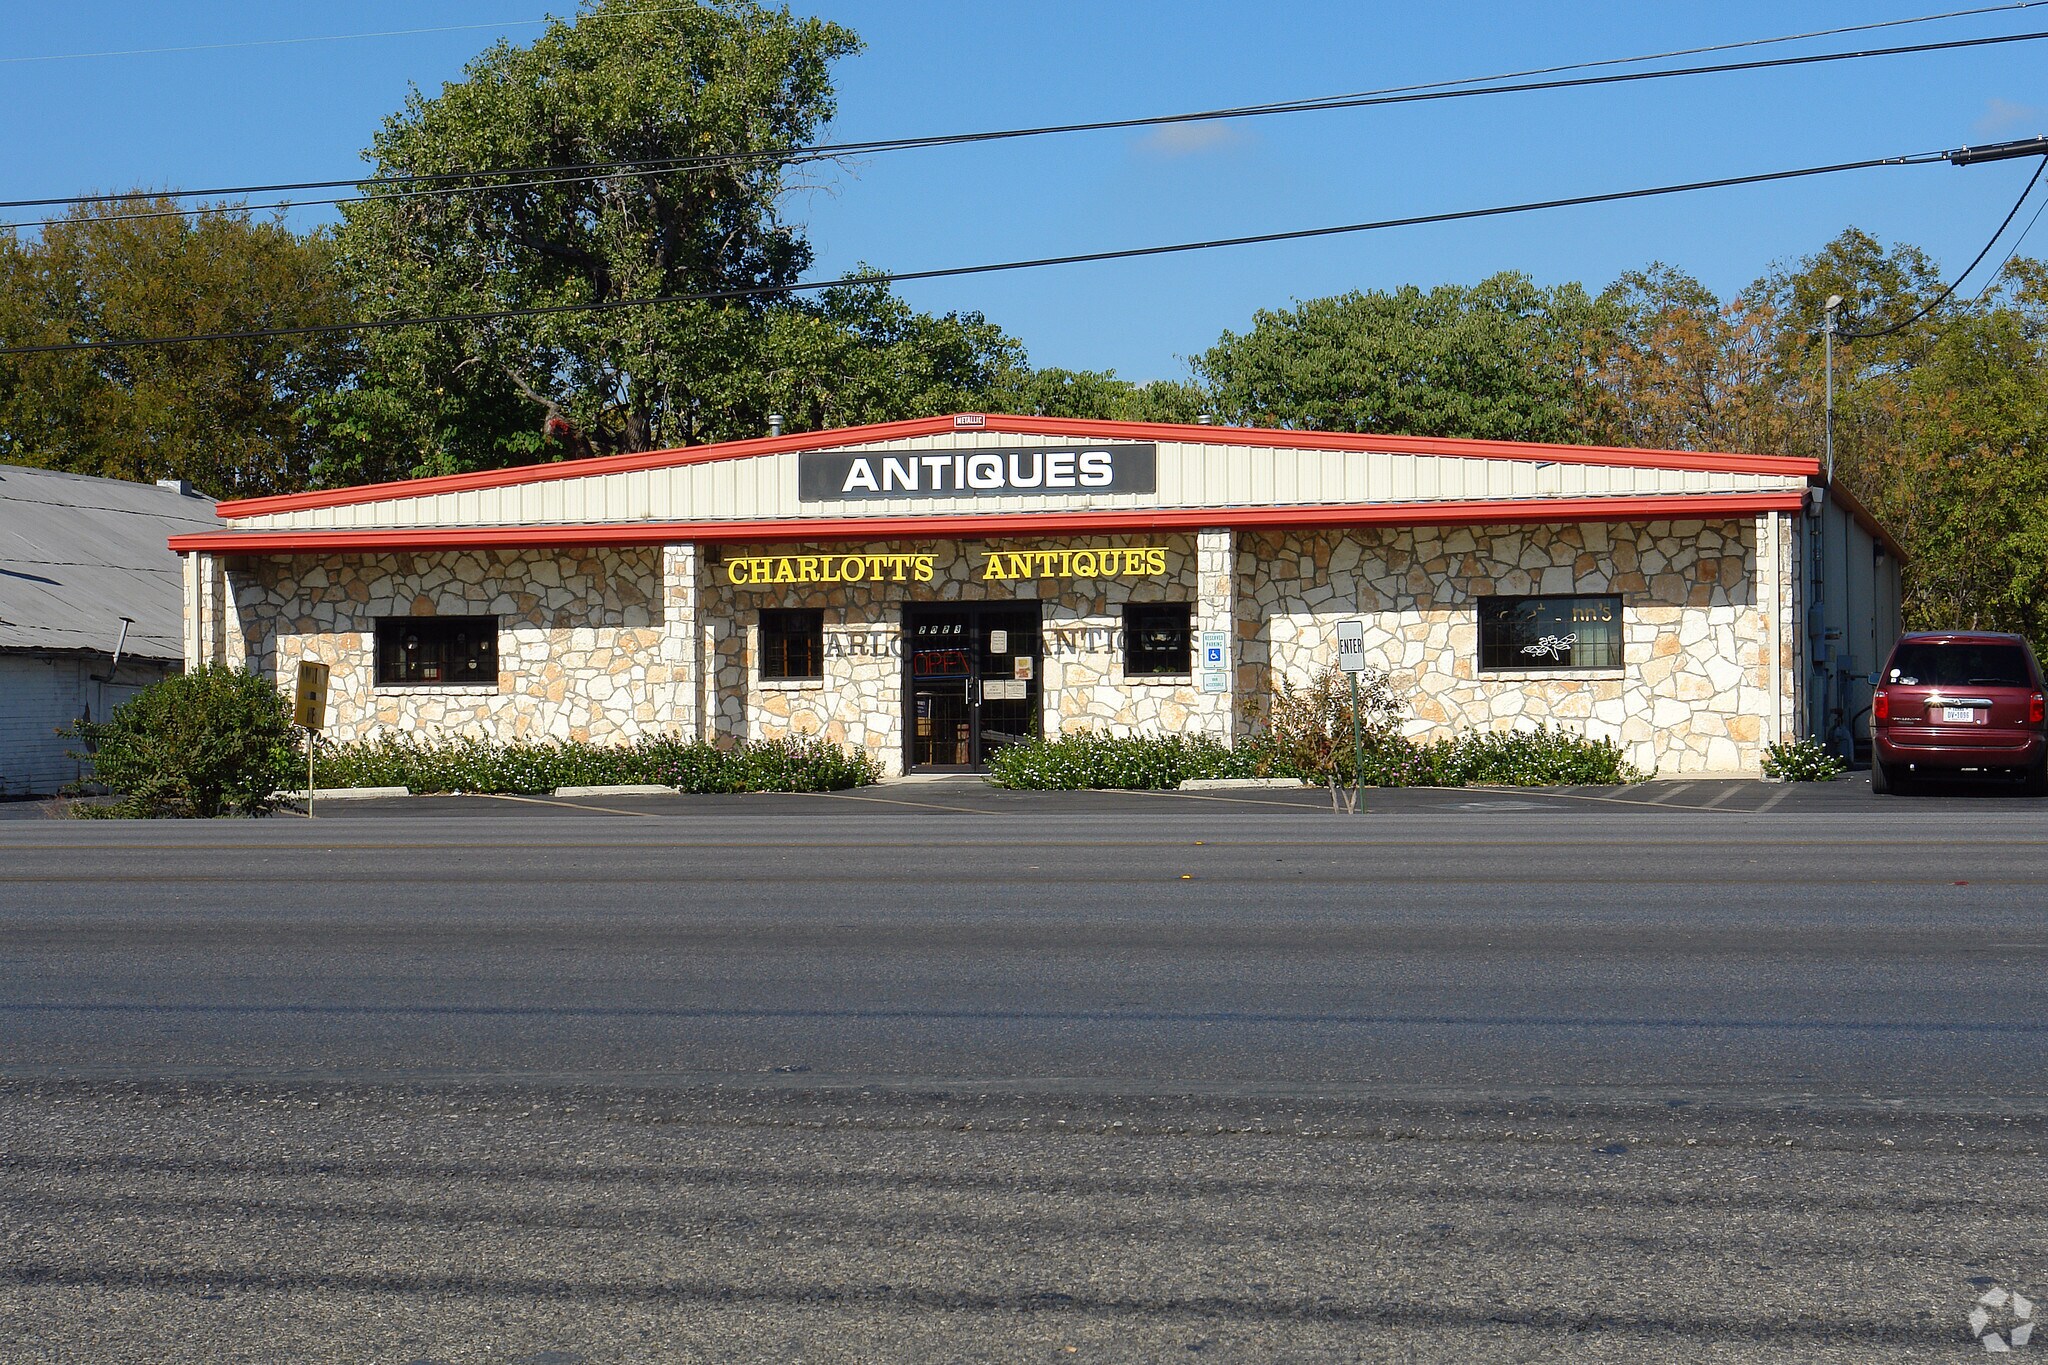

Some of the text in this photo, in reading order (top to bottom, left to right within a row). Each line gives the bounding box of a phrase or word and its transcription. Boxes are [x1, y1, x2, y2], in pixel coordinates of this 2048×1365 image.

[841, 451, 1114, 493] ANTIQUES
[727, 549, 1168, 586] CHARLOTT'S ANTIQUES
[1340, 638, 1363, 654] ENTER
